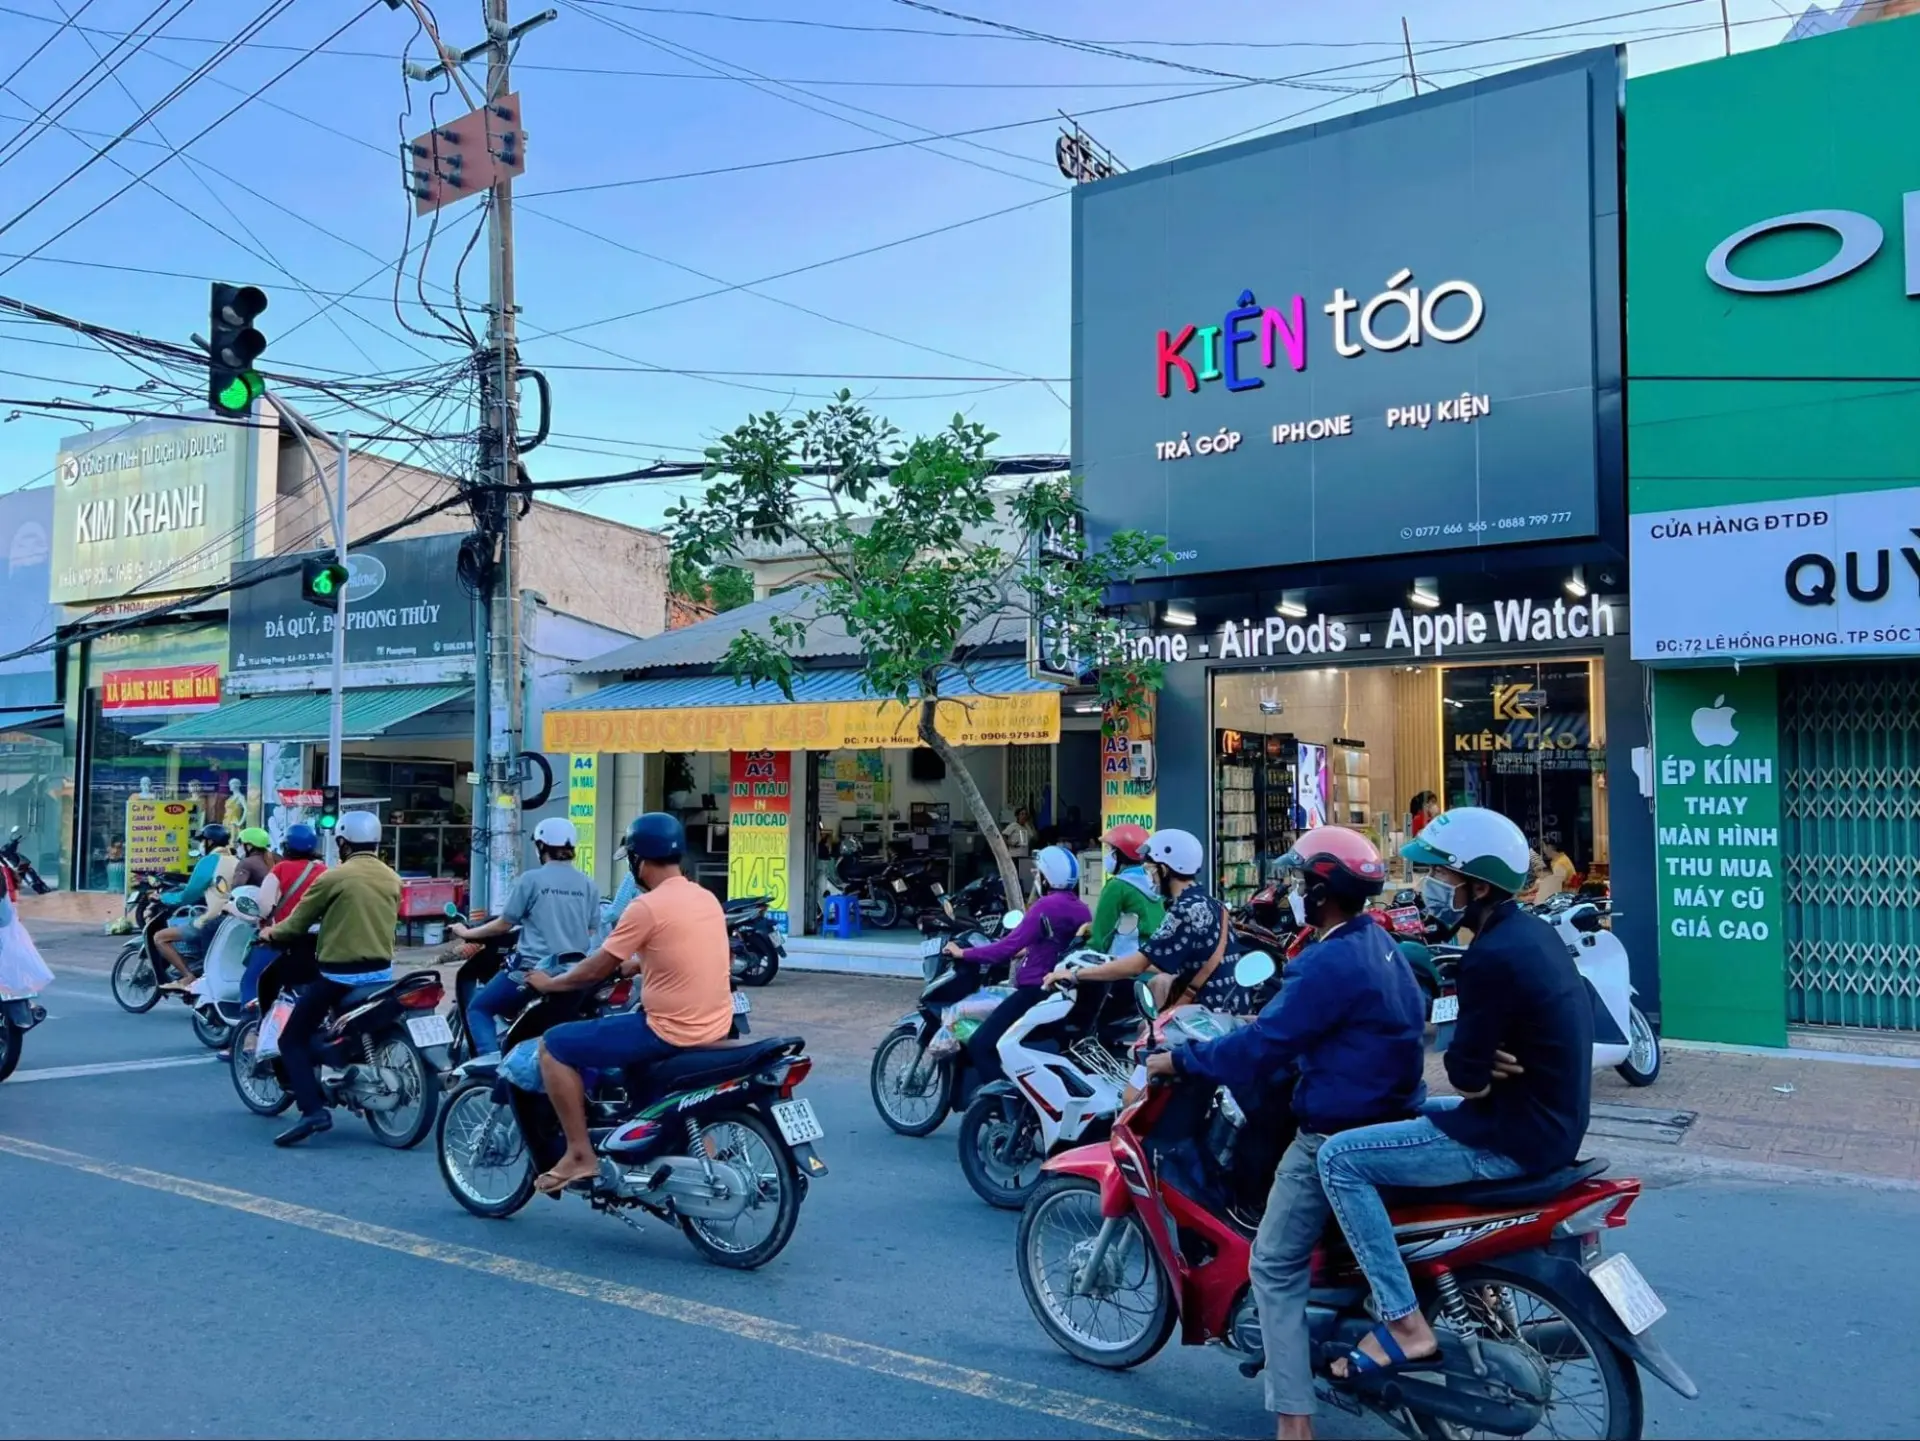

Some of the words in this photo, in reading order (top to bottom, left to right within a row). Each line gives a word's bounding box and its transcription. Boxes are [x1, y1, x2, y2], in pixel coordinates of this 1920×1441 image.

[1705, 188, 1920, 297] O
[1156, 289, 1306, 398] KIÊN
[1324, 267, 1485, 358] táo
[1156, 430, 1192, 461] TRẢ
[1195, 426, 1242, 457] GÓP
[1272, 415, 1353, 444] IPHONE
[1387, 402, 1432, 430] PHỤ
[1437, 392, 1491, 424] KIỆN
[81, 453, 104, 477] CÔNG
[106, 458, 118, 474] TY
[118, 449, 140, 470] TNHH
[190, 436, 205, 457] DU
[205, 432, 226, 458] LỊCH
[76, 498, 117, 544] KIM
[123, 484, 206, 536] KHANH
[1415, 526, 1440, 537] 0777
[1443, 523, 1463, 534] 666
[1467, 521, 1488, 532] 565
[1498, 516, 1525, 529] 0888
[1528, 514, 1549, 526] 799
[1551, 511, 1572, 524] 777
[1650, 517, 1693, 539] CỬA
[1697, 513, 1760, 536] HÀNG
[1764, 511, 1829, 530] ĐTDĐ
[265, 615, 285, 638] ĐÁ
[347, 608, 397, 630] PHONG
[400, 600, 441, 625] THỦY
[1220, 614, 1348, 659] AirPods
[1385, 608, 1487, 656] Apple
[1494, 593, 1615, 643] Watch
[1706, 633, 1725, 650] LÊ
[1728, 629, 1775, 649] HỒNG
[1847, 630, 1869, 643] TP
[1873, 624, 1911, 642] SÓC
[121, 677, 145, 701] HÀNG
[146, 679, 171, 699] SALE
[552, 711, 750, 746] PHOTOCOPY
[761, 707, 830, 743] 145
[1455, 728, 1512, 751] KIÊN
[1523, 726, 1578, 751] TÁO
[1106, 736, 1128, 752] A3
[574, 757, 593, 769] A4
[746, 762, 775, 777] A4
[1106, 757, 1129, 772] A4
[1661, 755, 1695, 784] ÉP
[1704, 754, 1772, 784] KÍNH
[733, 782, 749, 796] IN
[1106, 780, 1119, 796] IN
[1684, 796, 1748, 815] THAY
[732, 813, 787, 827] AUTOCAD
[1659, 823, 1711, 846] MÀN
[1718, 823, 1778, 846] HÌNH
[1665, 857, 1713, 877] THU
[1720, 858, 1773, 878] MUA
[730, 856, 787, 910] 145
[1673, 885, 1724, 907] MÁY
[1730, 886, 1765, 910] CŨ
[1671, 916, 1713, 938] GIÁ
[1718, 920, 1769, 941] CAO
[1443, 1212, 1540, 1239] BLADE
